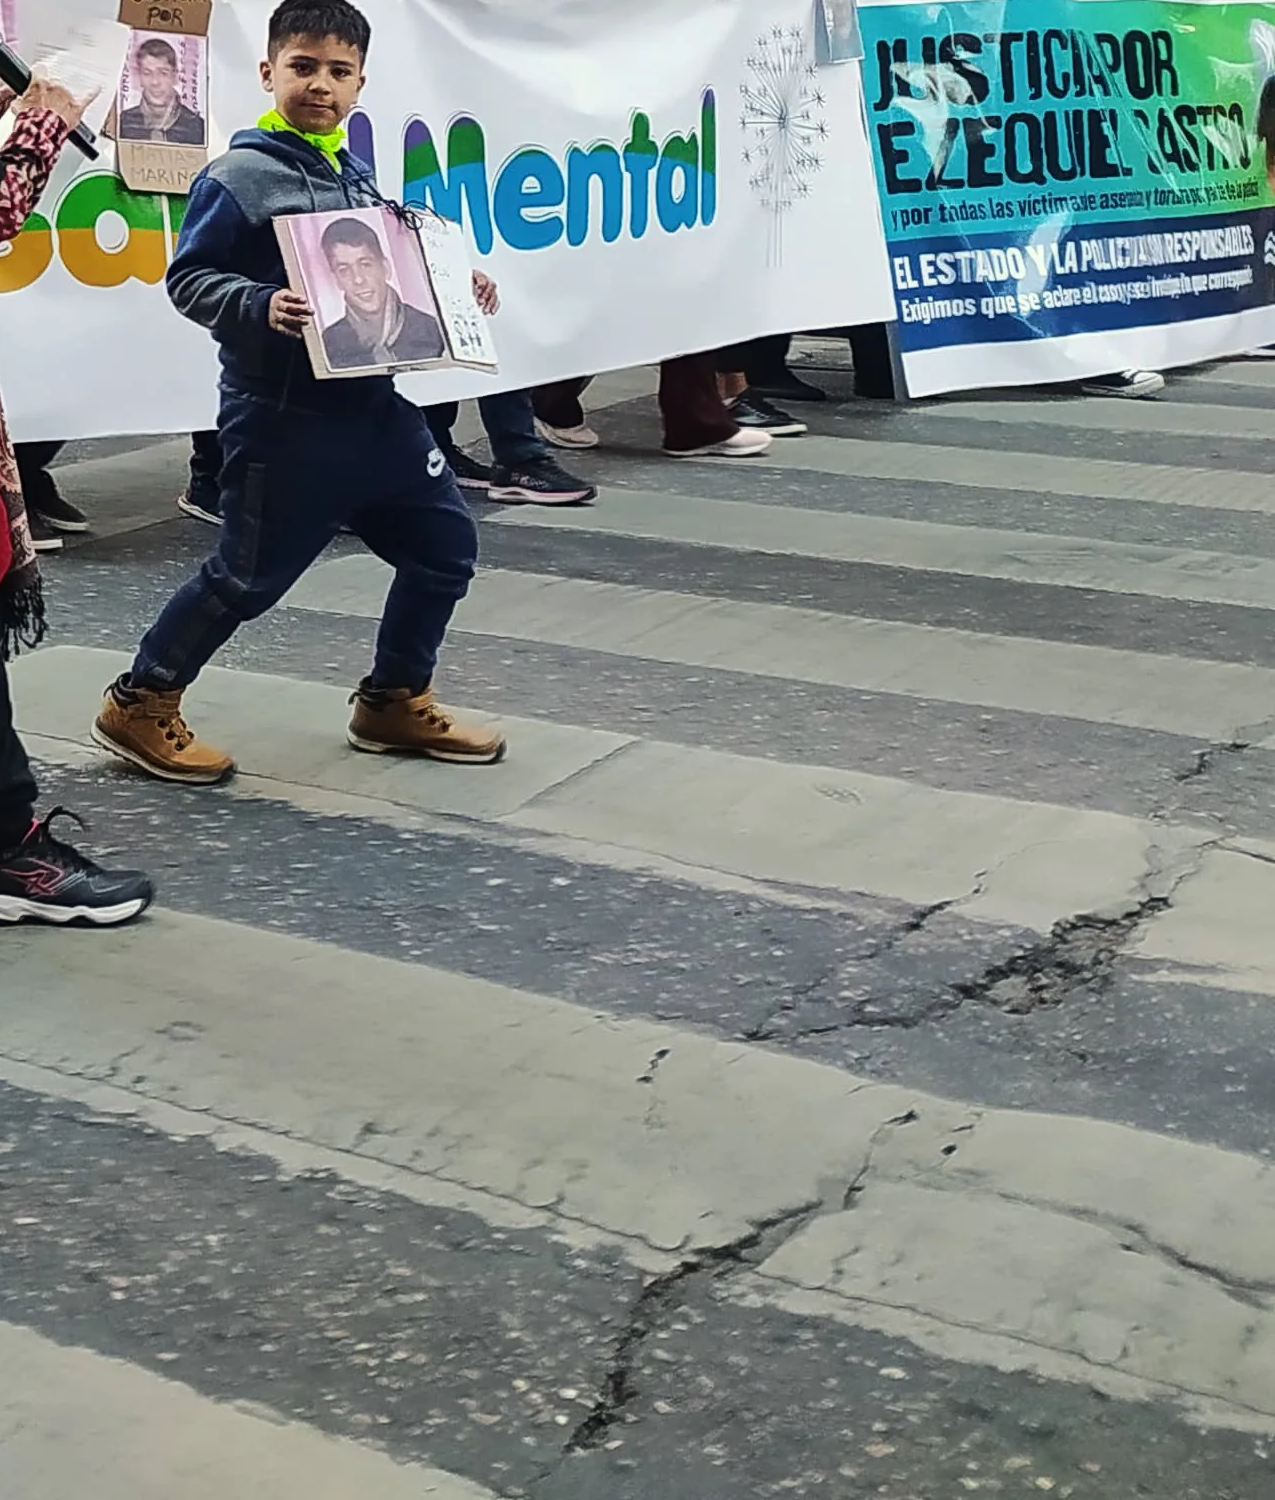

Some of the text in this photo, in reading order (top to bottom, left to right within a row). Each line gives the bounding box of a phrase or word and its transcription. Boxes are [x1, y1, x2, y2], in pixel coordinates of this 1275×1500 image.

[147, 7, 183, 27] POR
[874, 30, 1179, 110] JUSTICIA POR
[403, 84, 717, 256] Mental
[901, 206, 931, 228] por
[938, 199, 986, 223] todas
[988, 196, 1013, 217] las
[894, 257, 919, 290] EL
[922, 247, 1025, 287] ESTADO
[1027, 244, 1048, 277] Y
[1051, 242, 1079, 274] LA
[901, 296, 977, 325] Exigimos
[981, 293, 1017, 319] que
[1019, 291, 1041, 313] se
